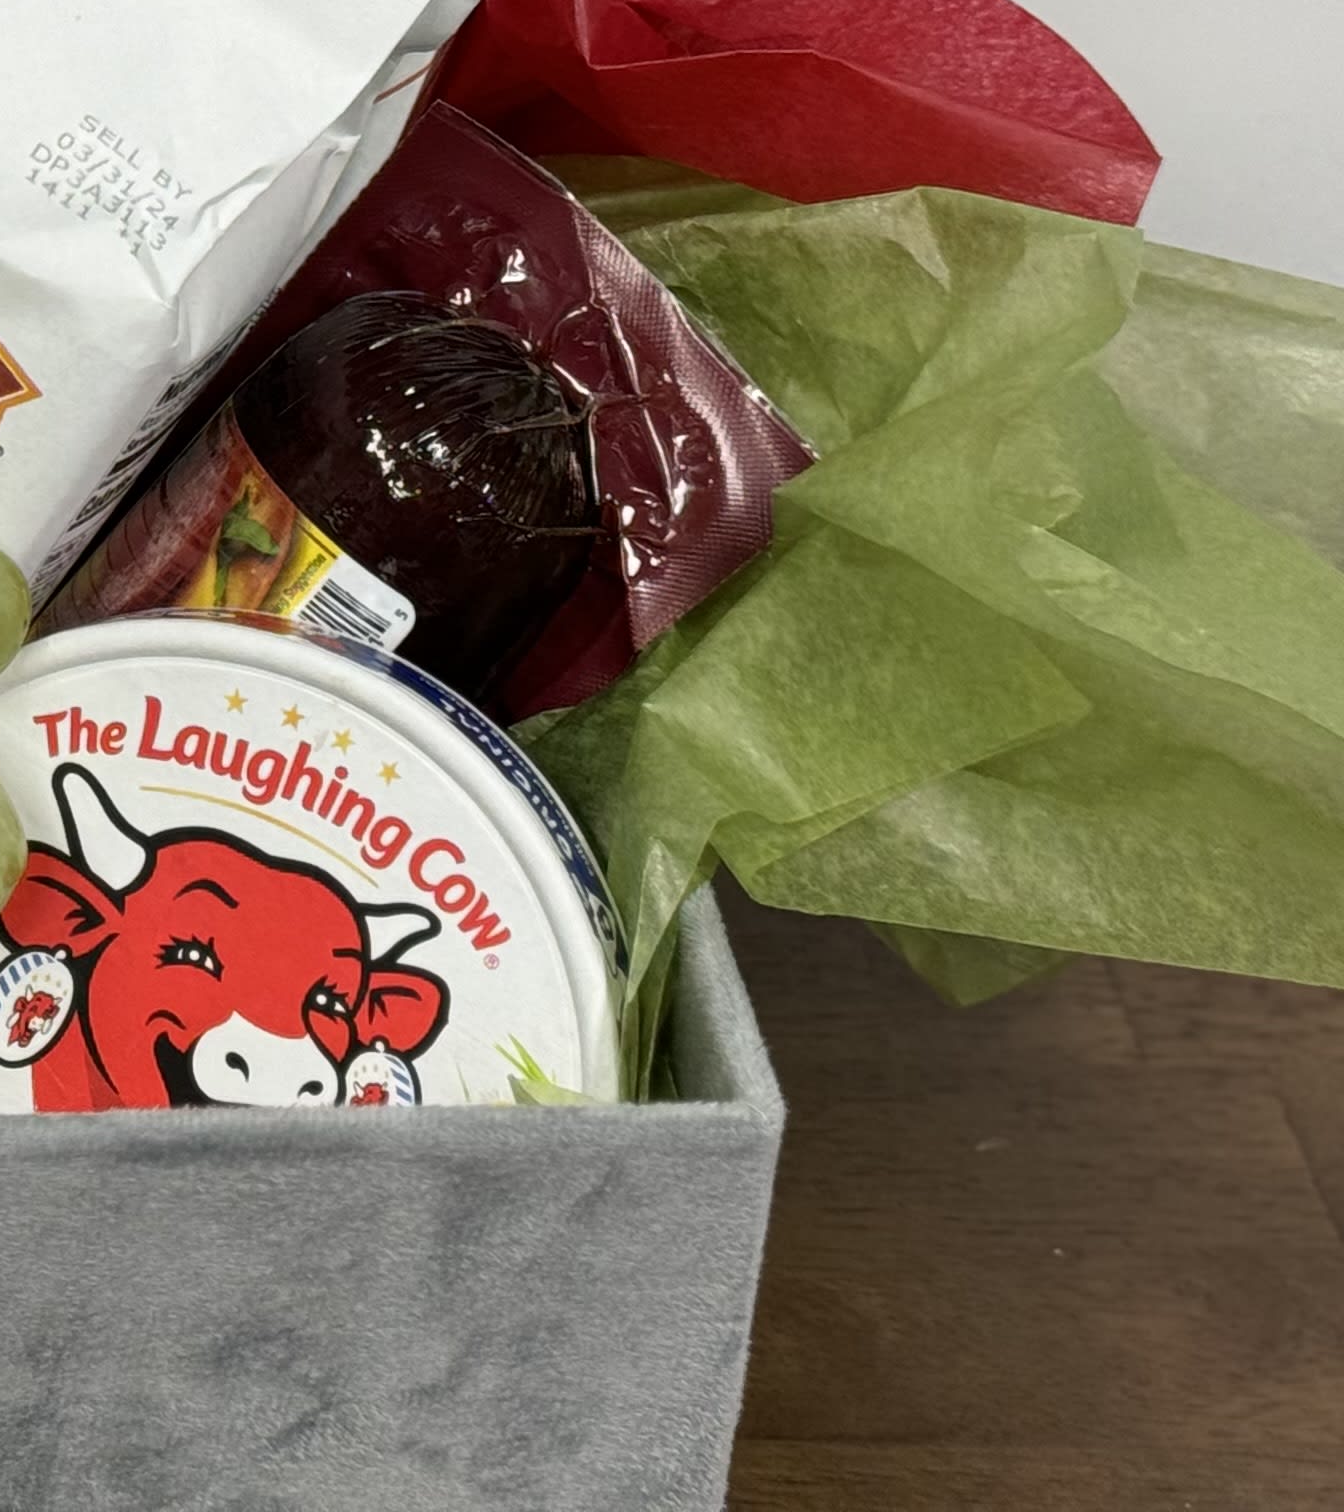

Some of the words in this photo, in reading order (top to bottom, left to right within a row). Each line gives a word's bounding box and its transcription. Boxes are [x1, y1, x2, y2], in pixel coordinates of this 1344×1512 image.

[25, 168, 92, 220] 1411
[30, 142, 167, 251] DP3A3113
[57, 132, 179, 231] 03/31/24
[79, 114, 140, 171] SELL
[152, 168, 192, 200] BY
[33, 705, 127, 758] The
[137, 695, 413, 870] Laughing
